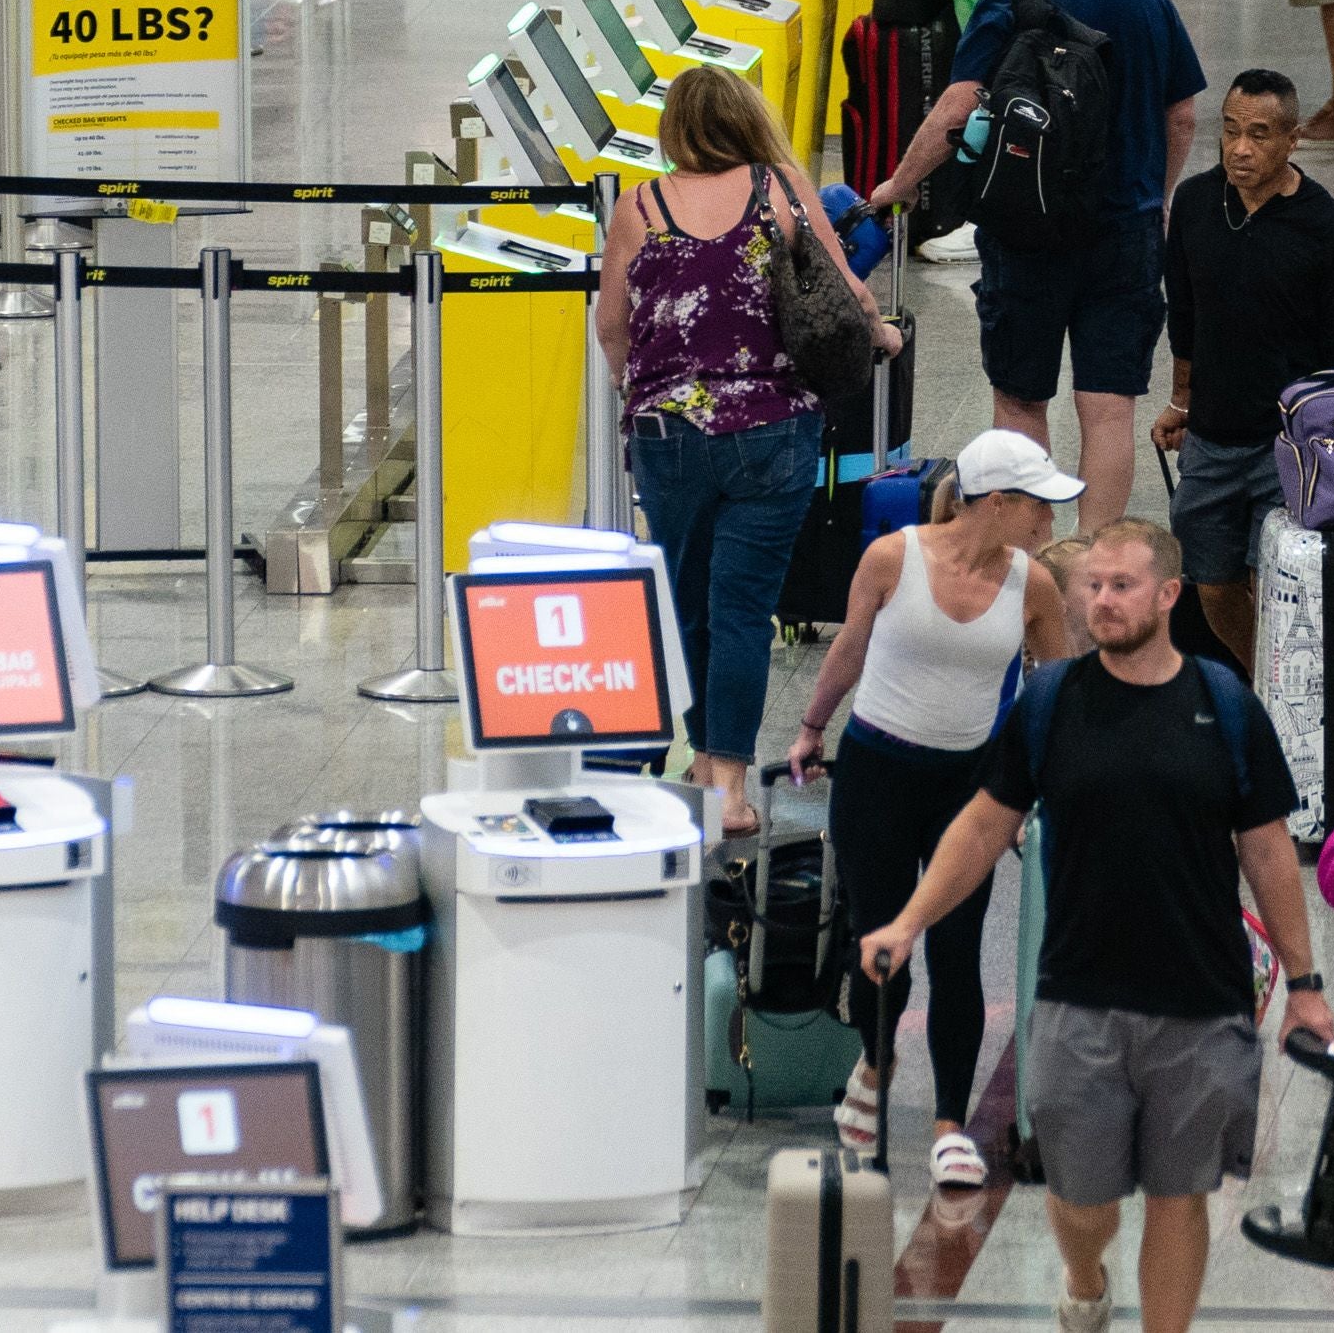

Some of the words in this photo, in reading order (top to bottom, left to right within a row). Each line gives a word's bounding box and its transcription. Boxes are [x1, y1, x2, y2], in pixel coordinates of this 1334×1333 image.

[49, 10, 98, 44] 40
[111, 6, 214, 41] LBS?
[60, 52, 88, 62] equipaje
[89, 52, 106, 60] pesa
[107, 50, 122, 59] más
[123, 50, 132, 58] de
[53, 116, 81, 125] CHECKED
[82, 116, 96, 124] BAG
[97, 115, 127, 123] WEIGHTS
[98, 183, 140, 195] spirit
[293, 186, 336, 200] spirit
[267, 273, 311, 288] spirit
[470, 275, 513, 290] spirit
[549, 605, 566, 637] 1
[496, 660, 636, 696] CHECK-IN
[199, 1102, 217, 1141] 1
[175, 1198, 229, 1223] HELP
[232, 1198, 287, 1223] DESK
